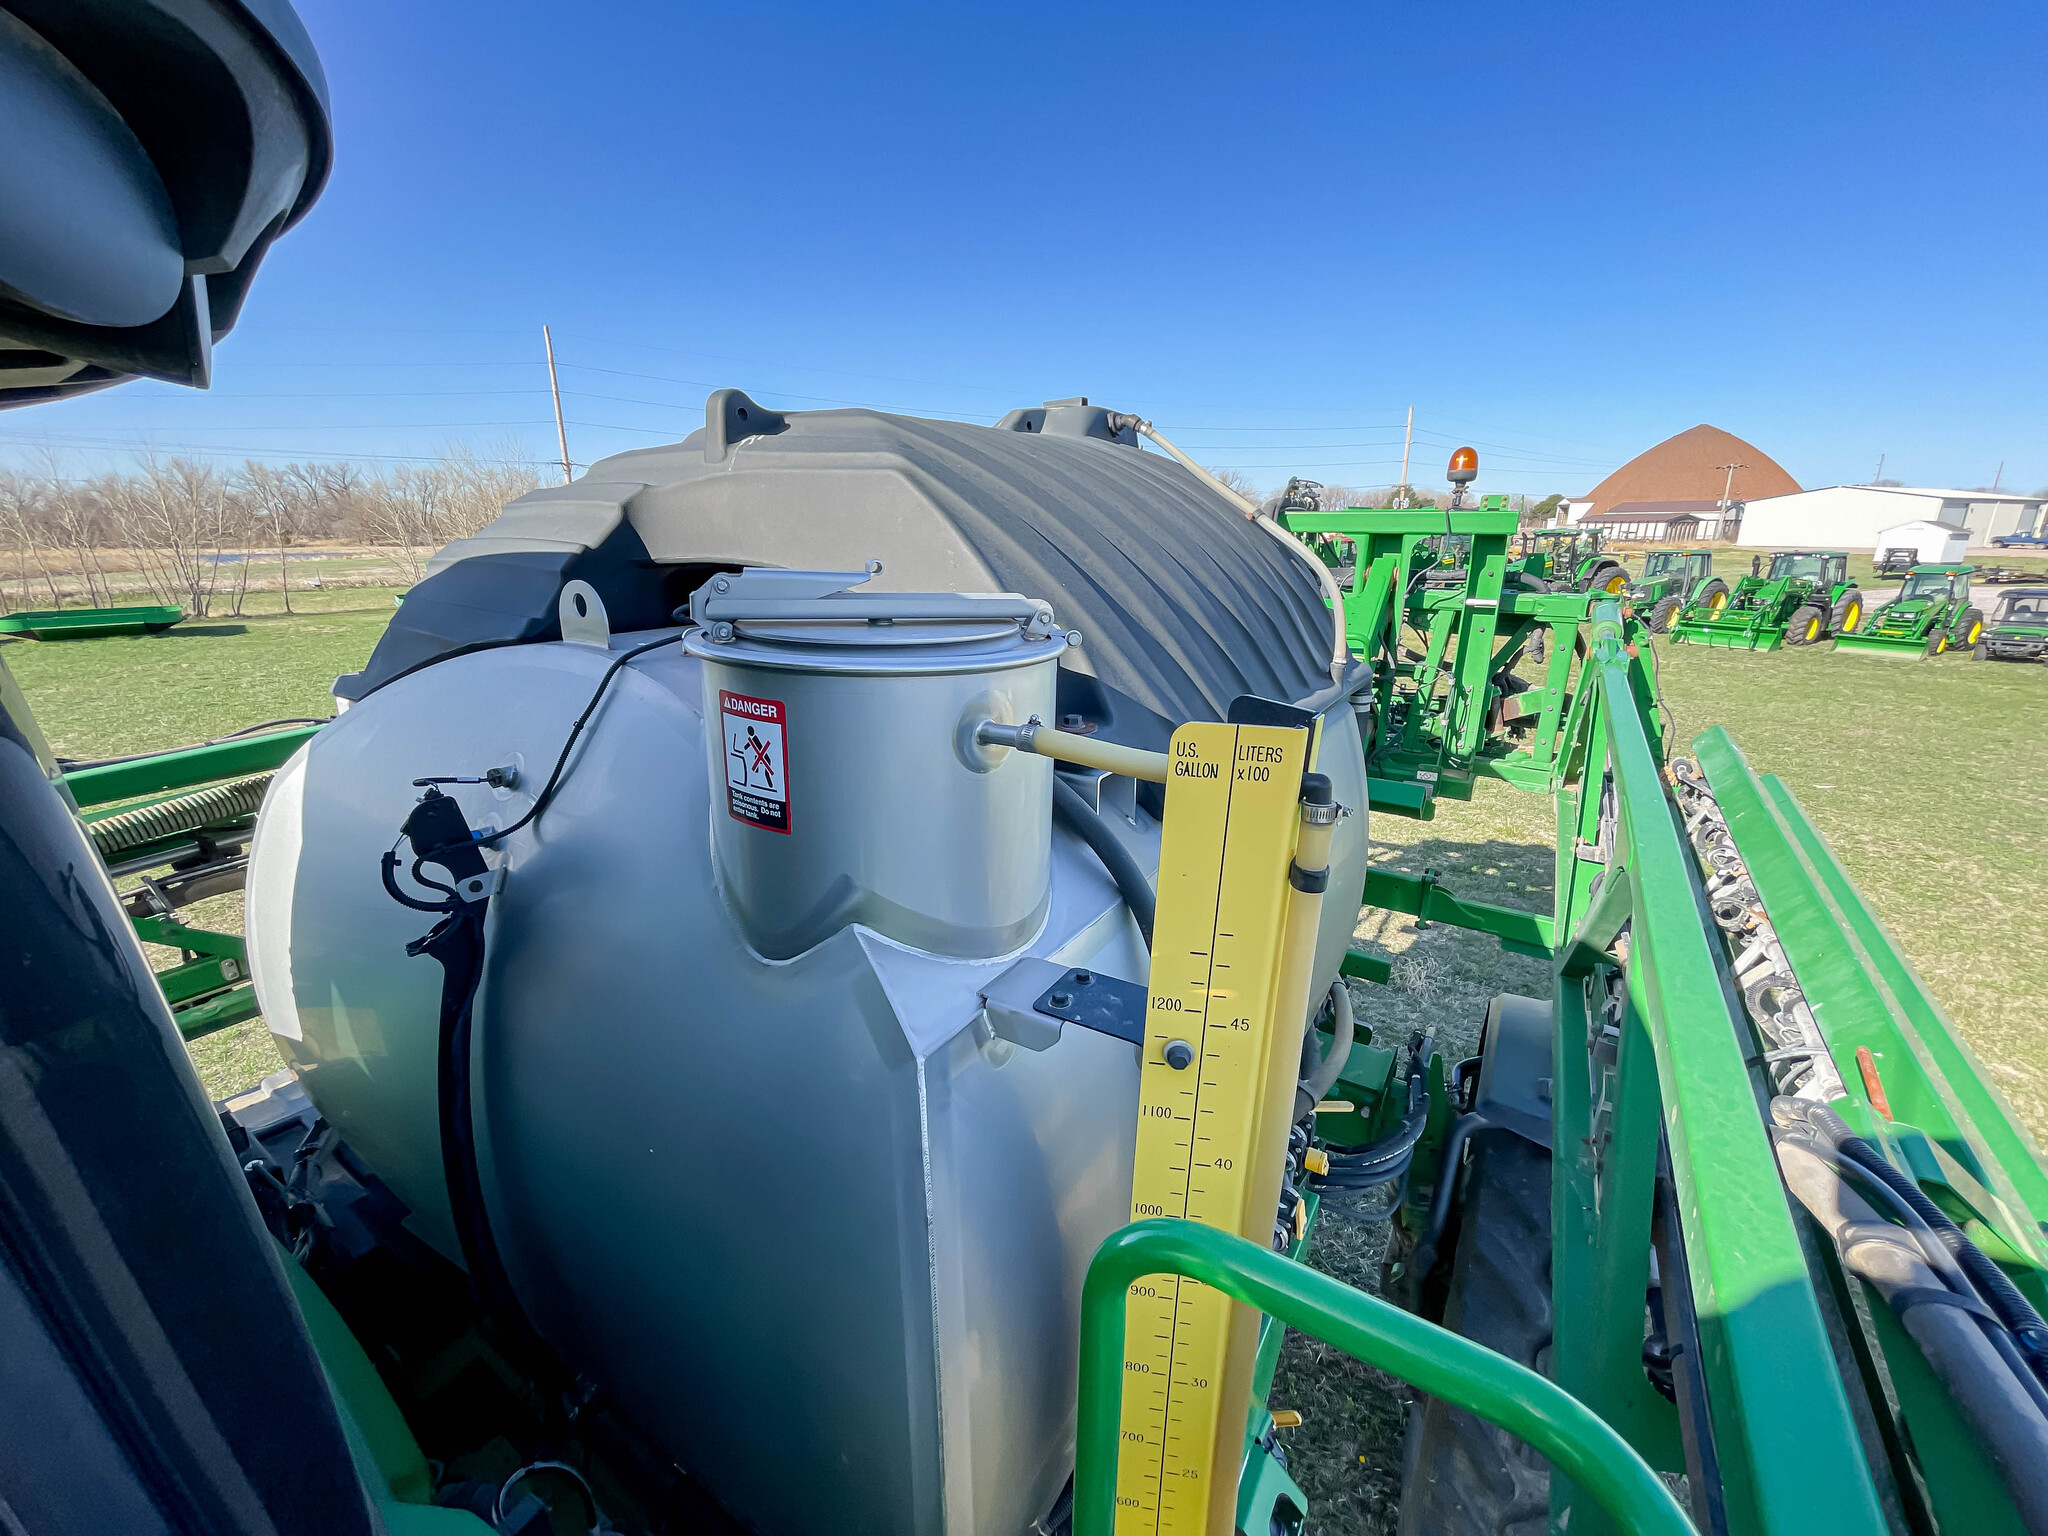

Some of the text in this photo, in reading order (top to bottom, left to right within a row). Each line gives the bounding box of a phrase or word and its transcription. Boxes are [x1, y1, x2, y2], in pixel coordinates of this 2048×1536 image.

[731, 698, 778, 718] DANGER
[1176, 741, 1199, 758] U.S.
[1238, 745, 1283, 763] LITERS
[1175, 761, 1219, 779] GALLON
[1237, 766, 1270, 782] x100
[760, 807, 769, 815] Do
[770, 810, 781, 818] not
[1151, 996, 1182, 1012] 1200
[1230, 1018, 1250, 1032] 45
[1143, 1104, 1172, 1119] 1100
[1214, 1158, 1233, 1171] 40
[1135, 1203, 1163, 1217] 1000
[1130, 1284, 1156, 1298] 900
[1125, 1361, 1150, 1374] 800
[1191, 1377, 1208, 1389] 30
[1121, 1431, 1145, 1444] 700
[1182, 1469, 1199, 1480] 25
[1116, 1497, 1140, 1508] 600
